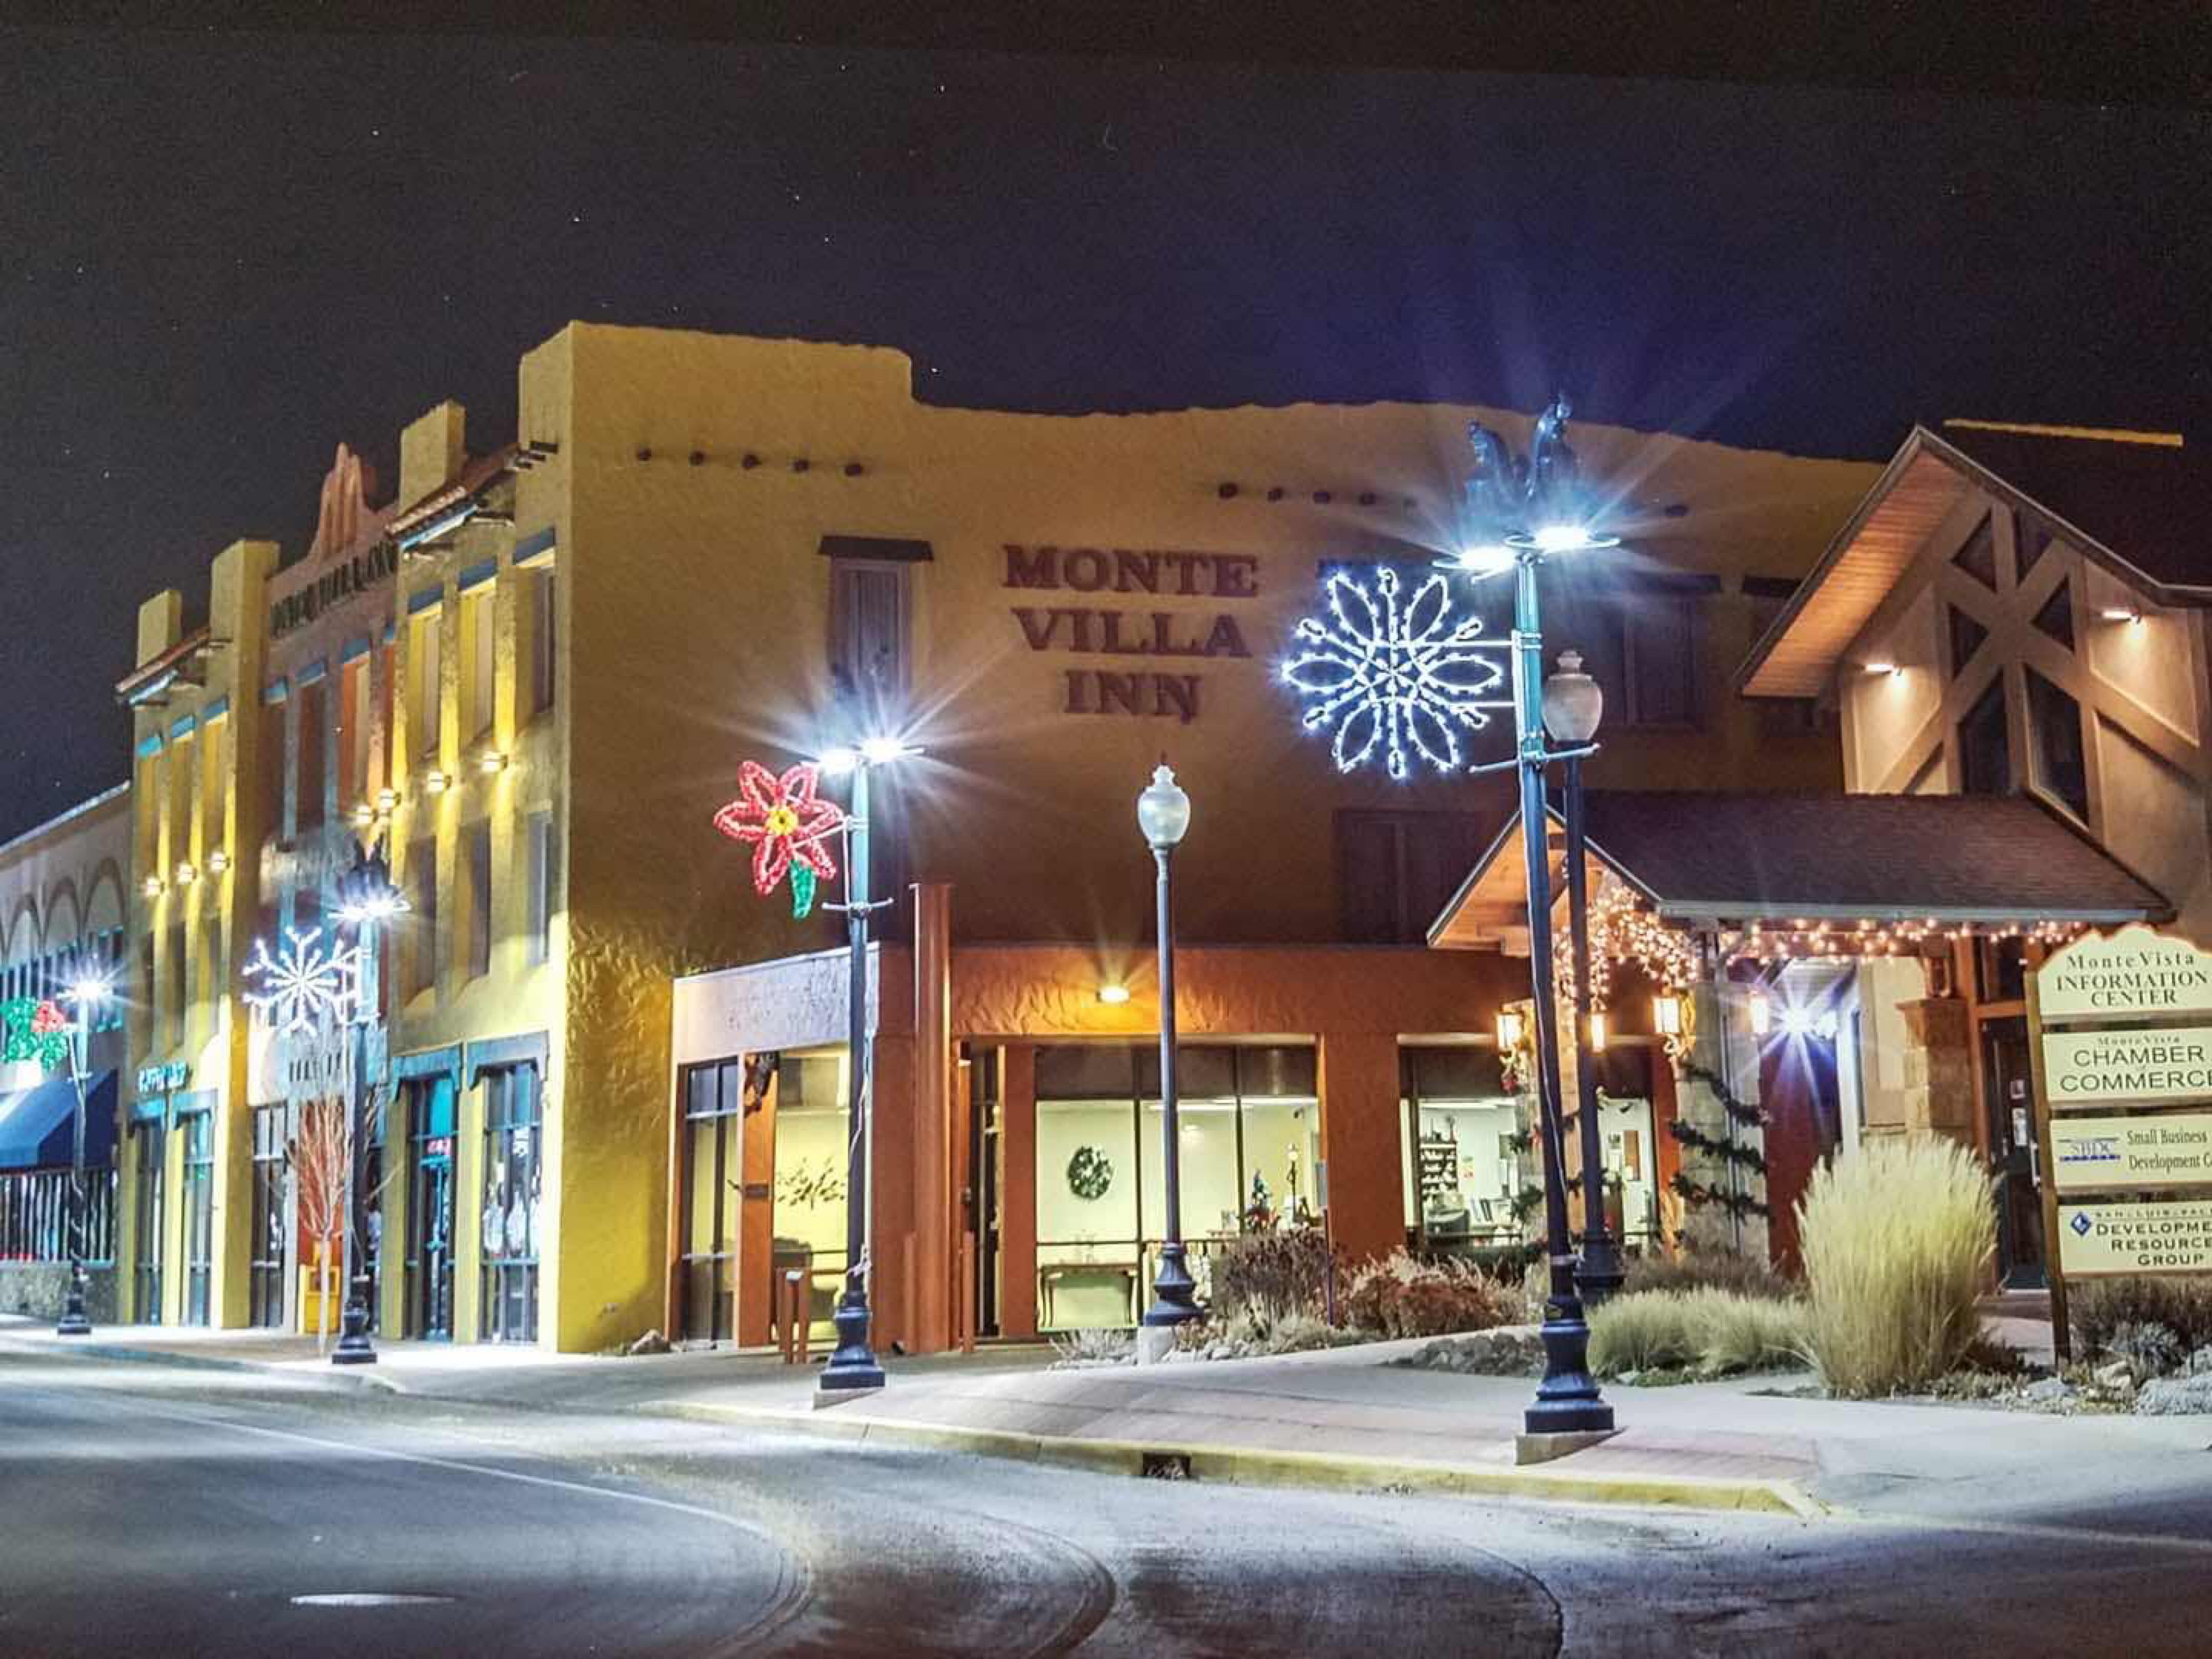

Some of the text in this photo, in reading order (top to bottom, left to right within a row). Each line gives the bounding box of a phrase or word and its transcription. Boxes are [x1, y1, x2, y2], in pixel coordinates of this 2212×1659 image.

[1002, 544, 1258, 598] MONTE
[1010, 608, 1253, 658] VILLA
[1064, 670, 1202, 722] INN
[2056, 970, 2208, 991] INFORMATION
[2091, 989, 2177, 1006] CENTER
[2074, 1045, 2205, 1067] CHAMBER
[2060, 1070, 2212, 1092] COMMERC
[2127, 1126, 2207, 1144] Small Business
[2128, 1154, 2200, 1174] Development
[2137, 1252, 2204, 1266] GROUP
